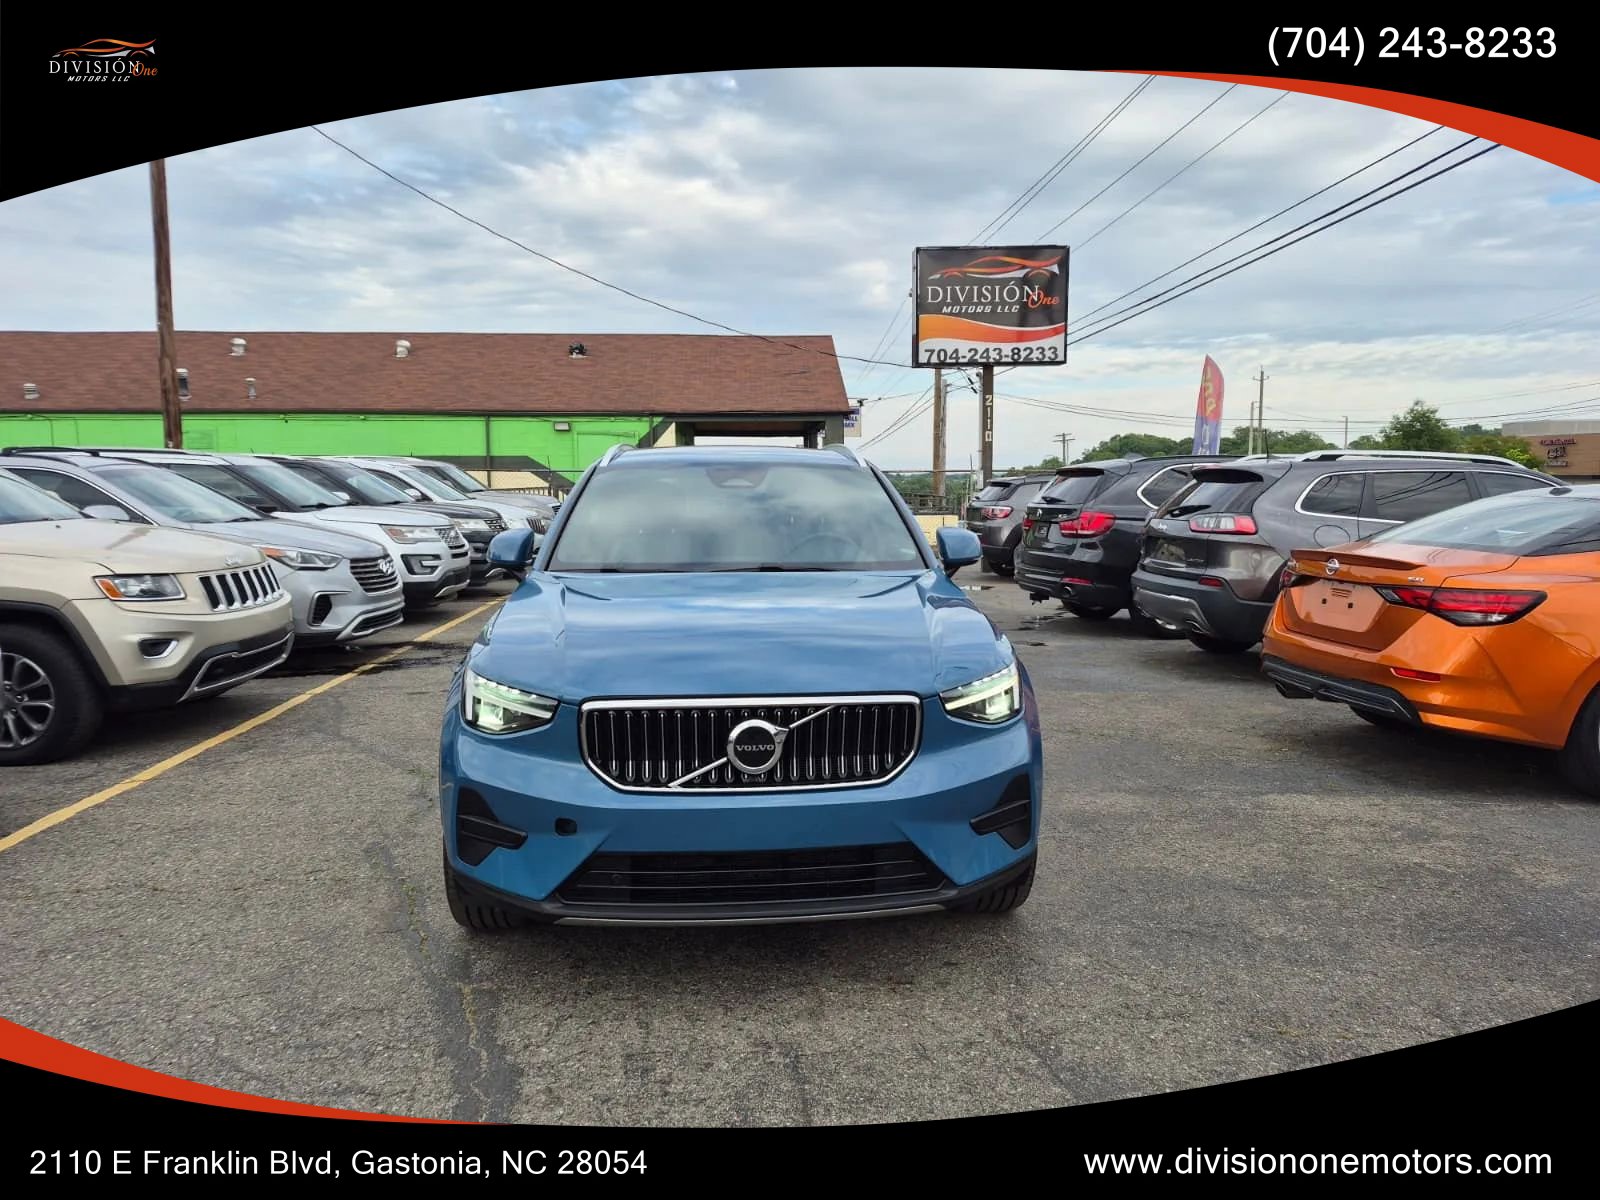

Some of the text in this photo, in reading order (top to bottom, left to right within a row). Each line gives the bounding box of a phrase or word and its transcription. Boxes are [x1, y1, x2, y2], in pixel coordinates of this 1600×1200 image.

[927, 281, 1061, 309] DIVISIÓN One
[942, 304, 1020, 314] MOTORS LLC
[924, 346, 1059, 364] 704-243-8233
[735, 744, 775, 752] VOLVO
